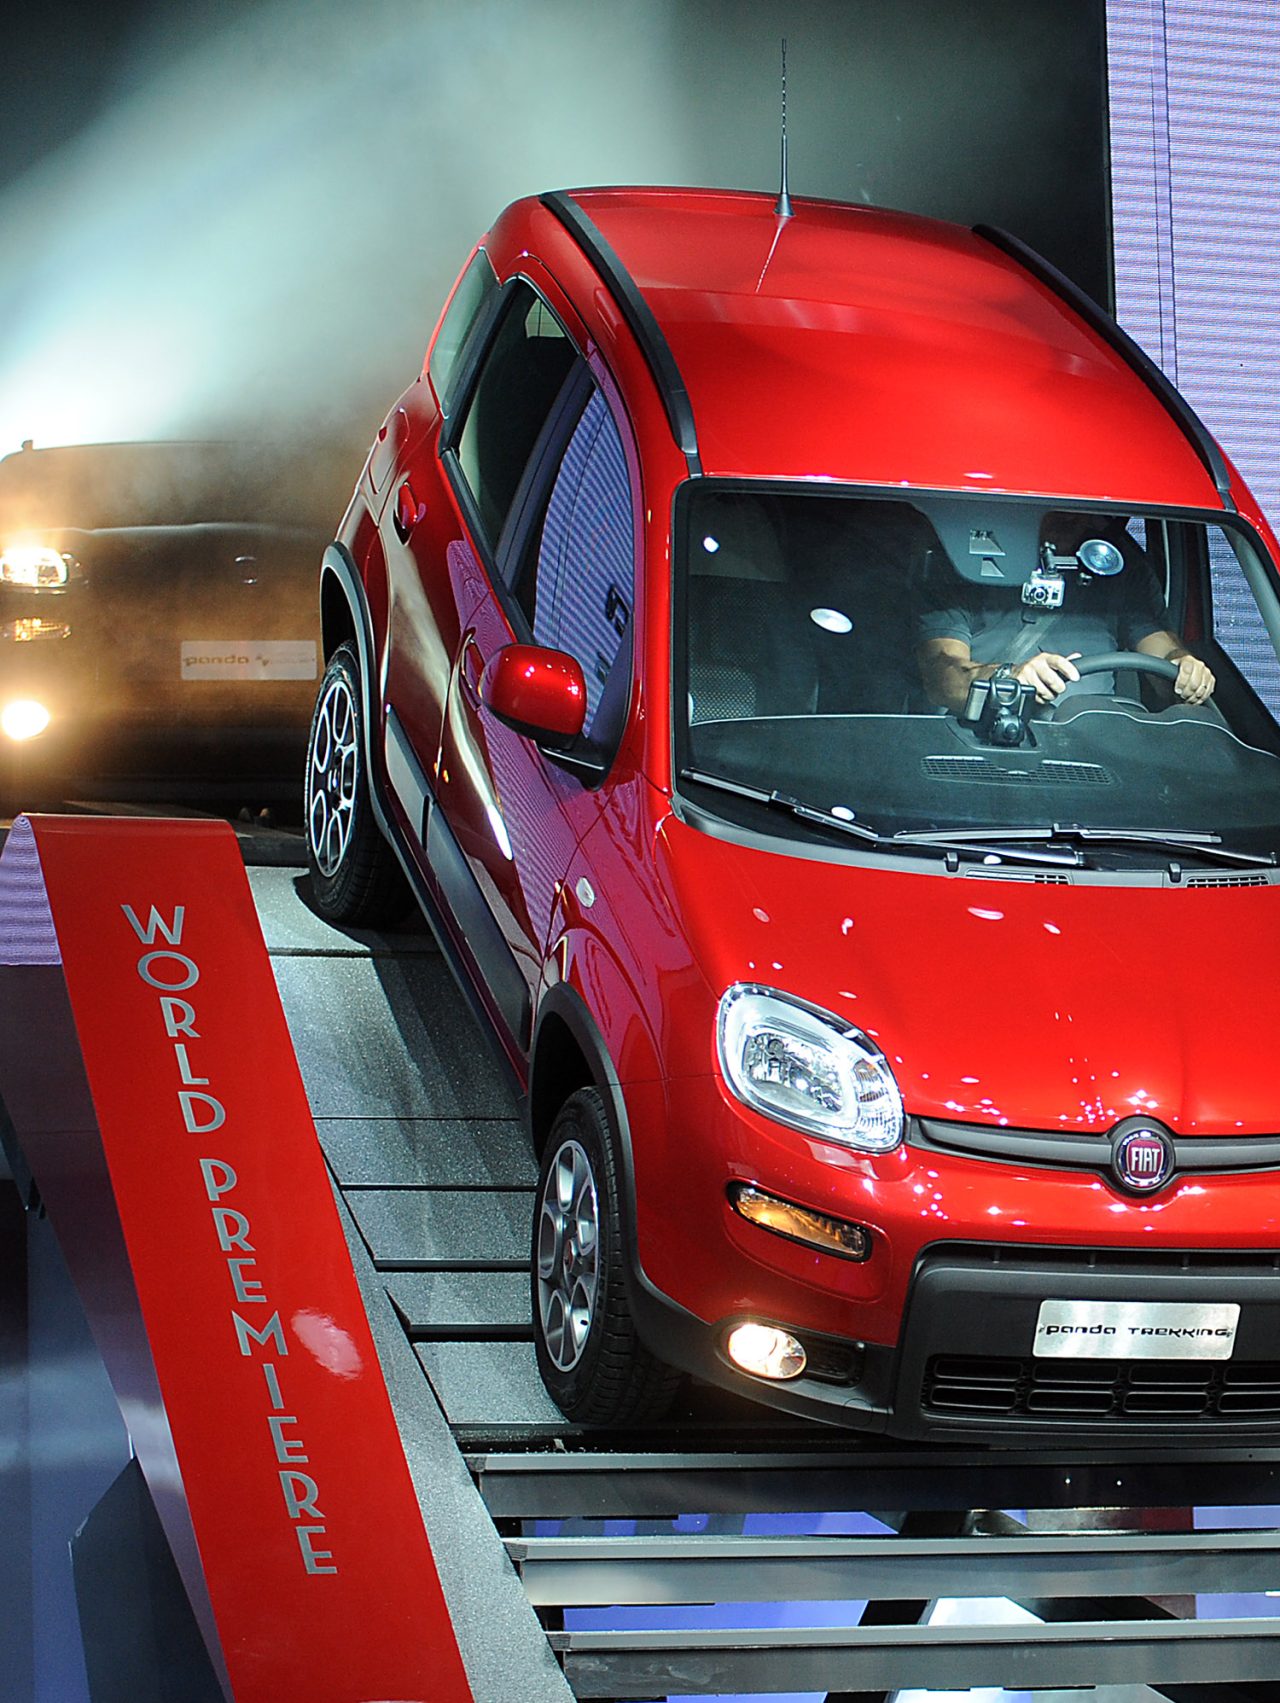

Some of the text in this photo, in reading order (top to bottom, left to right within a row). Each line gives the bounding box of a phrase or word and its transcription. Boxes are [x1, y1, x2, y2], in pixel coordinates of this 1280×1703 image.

[1131, 1147, 1160, 1172] FIAT
[120, 904, 338, 1575] WORLD PREMIERE
[1046, 1325, 1116, 1336] panda
